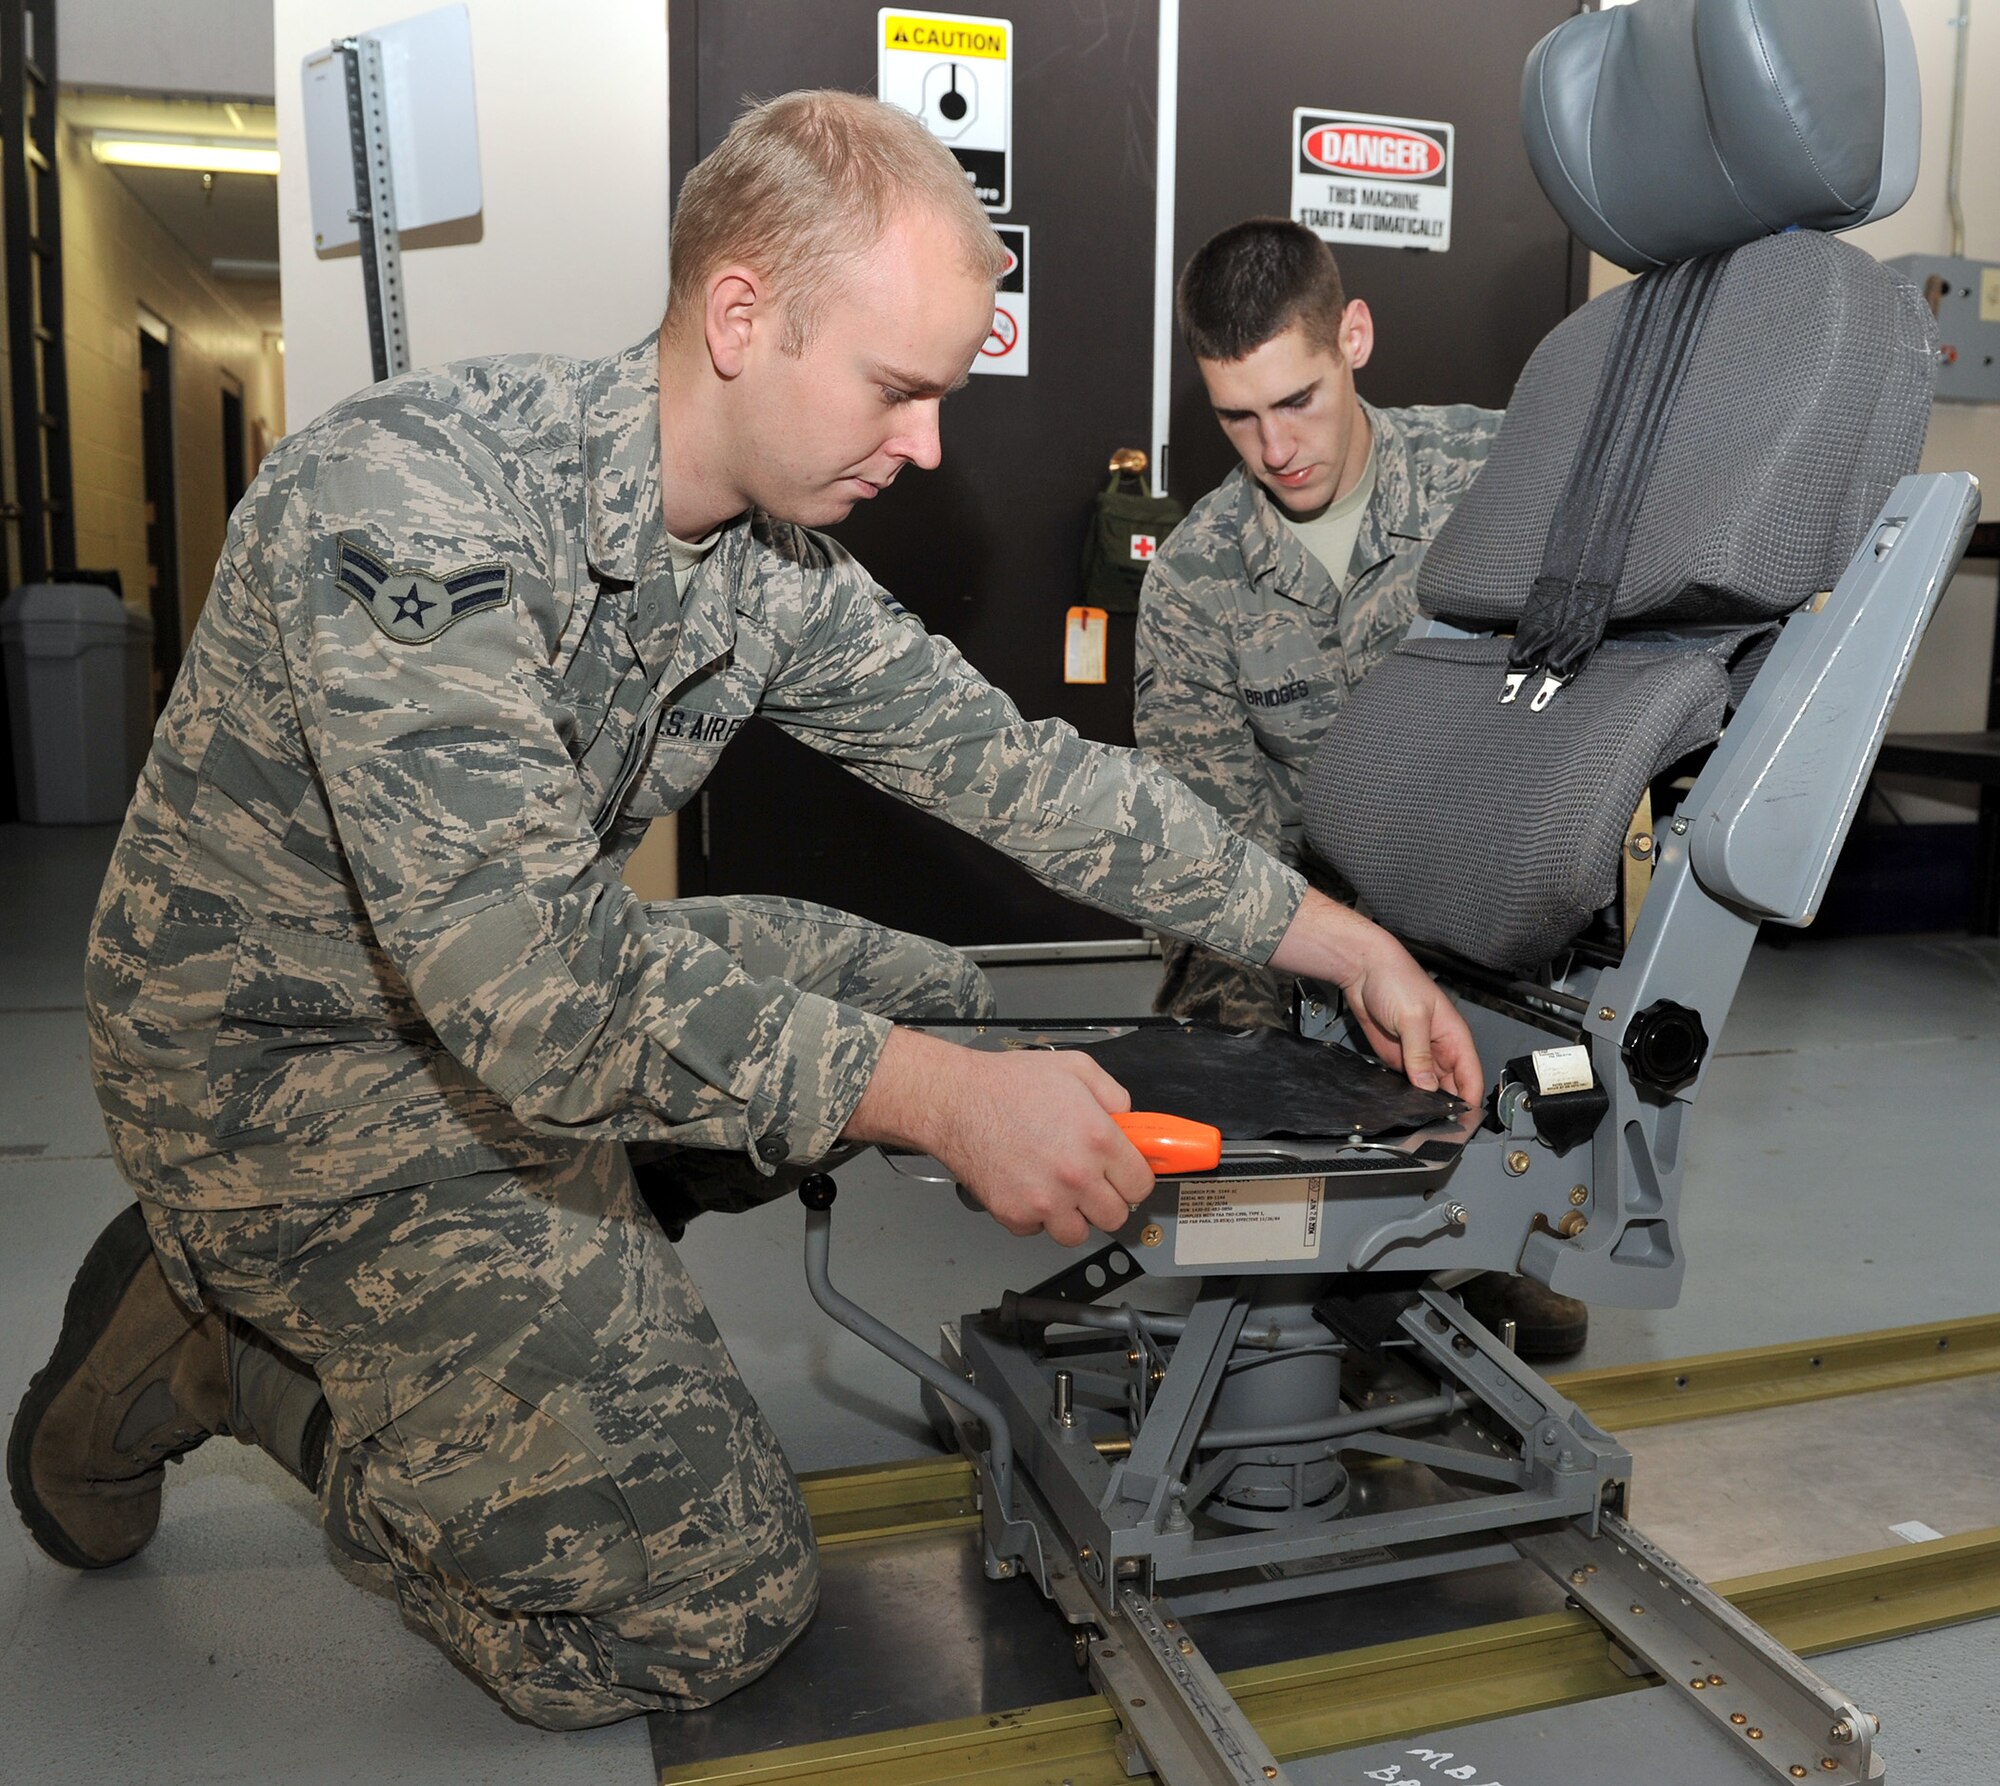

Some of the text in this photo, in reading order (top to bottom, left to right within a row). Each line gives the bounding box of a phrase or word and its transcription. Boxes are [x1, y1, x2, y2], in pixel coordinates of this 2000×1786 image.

[912, 26, 1001, 52] CAUTION
[1321, 131, 1429, 172] DANGER
[1328, 186, 1420, 211] THIS MACHINE
[1300, 208, 1445, 238] STARTS AUTOMATICALLY
[1243, 680, 1309, 708] BRIDGES
